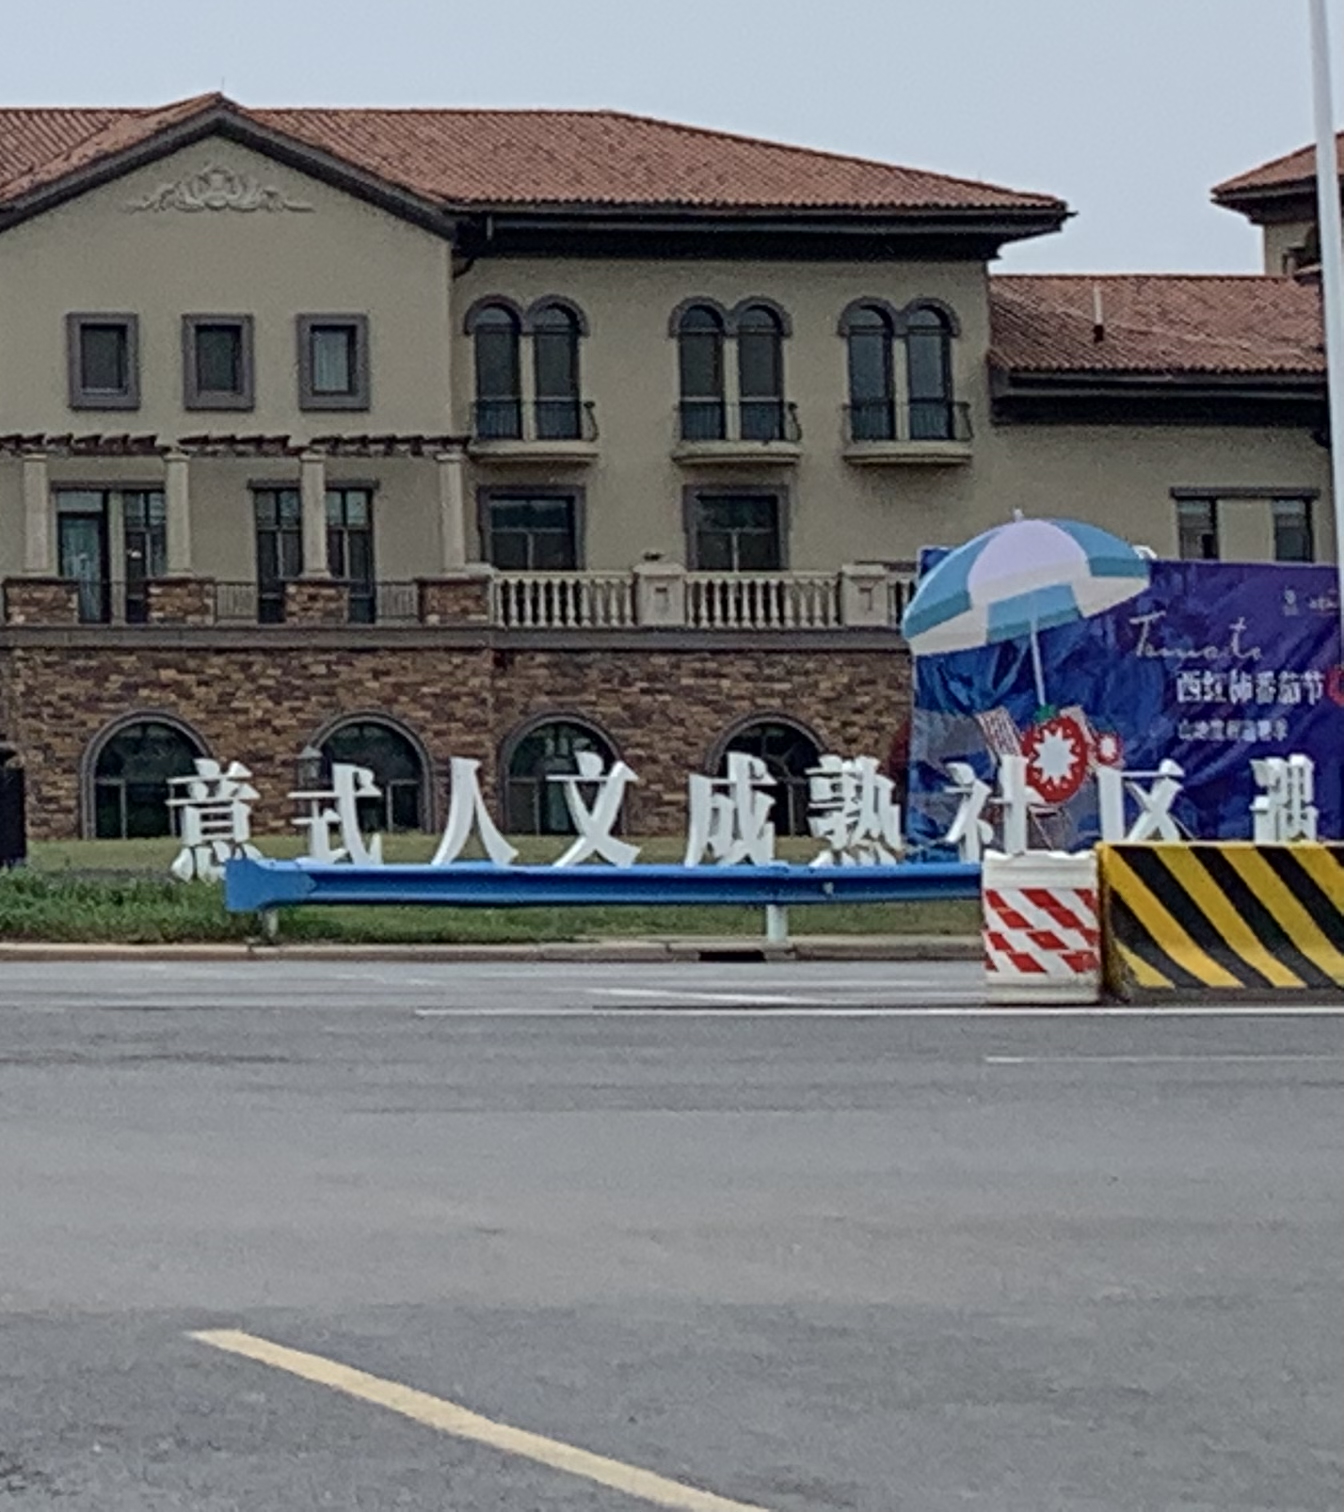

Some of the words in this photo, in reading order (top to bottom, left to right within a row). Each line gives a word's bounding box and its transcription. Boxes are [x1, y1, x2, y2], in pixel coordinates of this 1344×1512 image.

[1176, 669, 1324, 706] 西红柿番茄节
